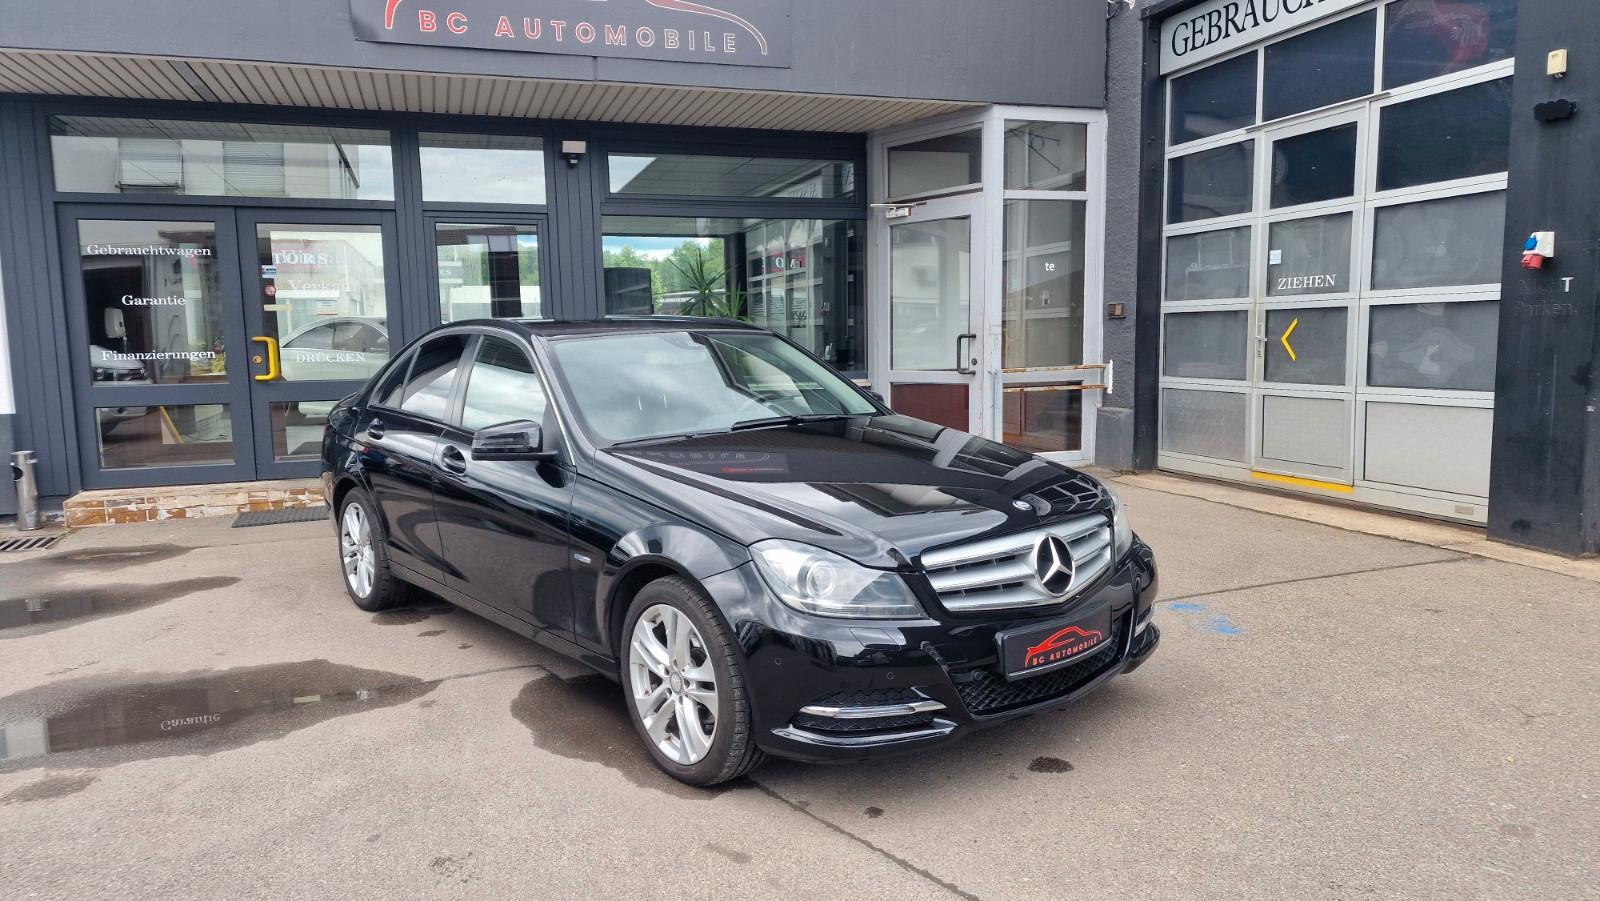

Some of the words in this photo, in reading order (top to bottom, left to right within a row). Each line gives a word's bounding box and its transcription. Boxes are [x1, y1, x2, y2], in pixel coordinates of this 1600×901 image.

[418, 9, 468, 34] BC
[494, 16, 736, 53] AUTOMOBILE
[1171, 0, 1326, 57] GEBRAUC
[86, 244, 212, 258] Gebrauchtwagen
[1277, 273, 1337, 290] ZIEHEN
[121, 294, 186, 307] Garantie
[101, 349, 217, 363] Finanzierungen
[295, 351, 365, 363] DRÜCKEN
[1032, 657, 1045, 666] BC
[1049, 638, 1097, 660] AUTOMOBILE
